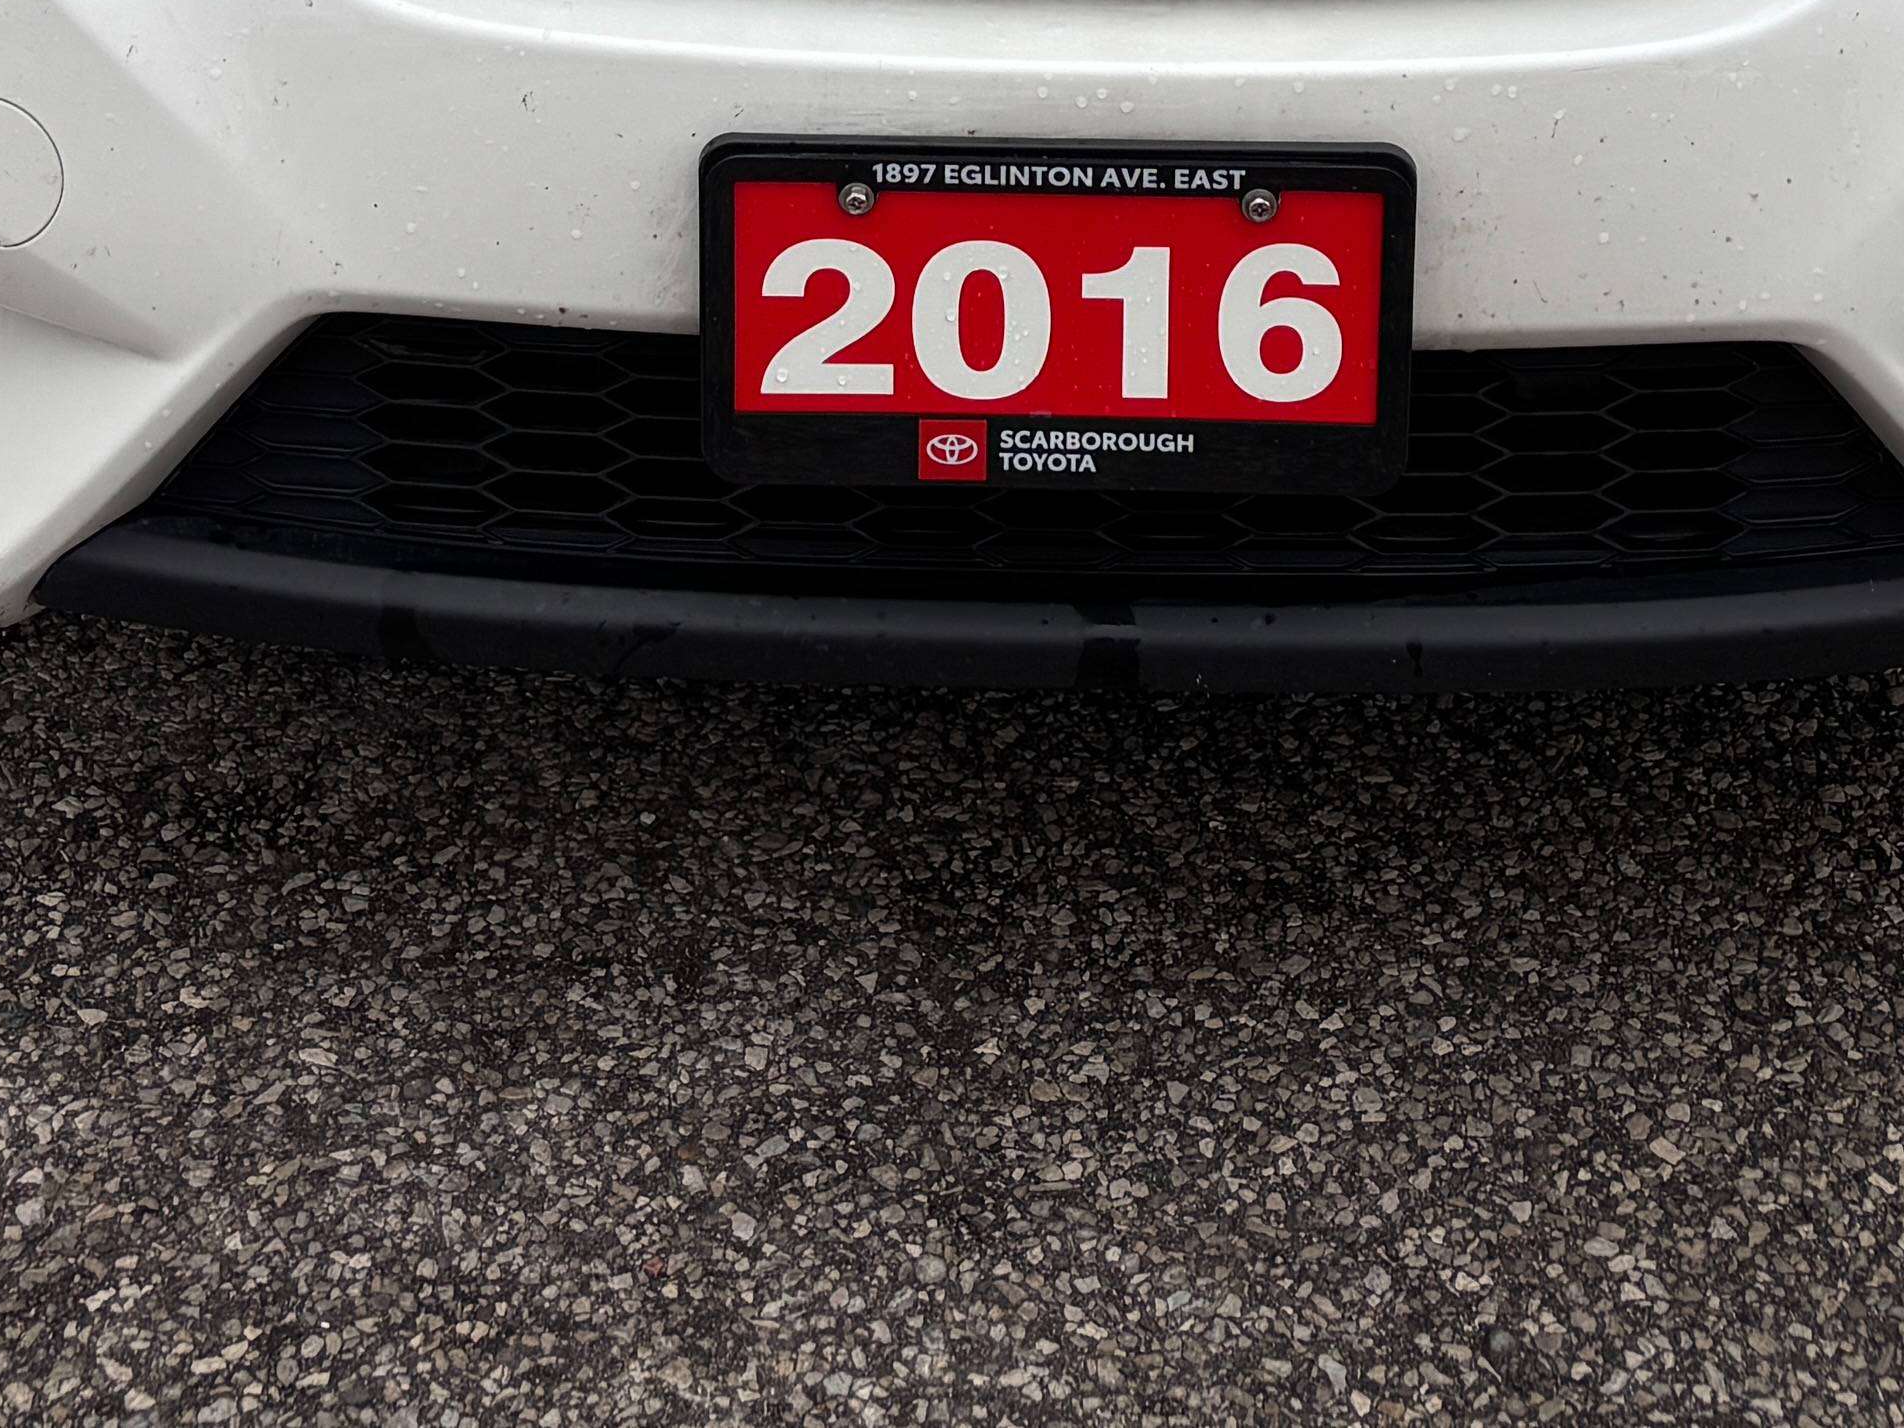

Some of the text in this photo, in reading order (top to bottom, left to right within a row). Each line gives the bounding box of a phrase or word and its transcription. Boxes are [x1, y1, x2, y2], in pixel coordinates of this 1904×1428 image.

[872, 163, 1246, 191] 1897 EGLINTON AVE. EAST
[760, 238, 1343, 403] 2016
[999, 430, 1195, 453] SCARBOROUGH
[999, 452, 1097, 473] TOYOTA
